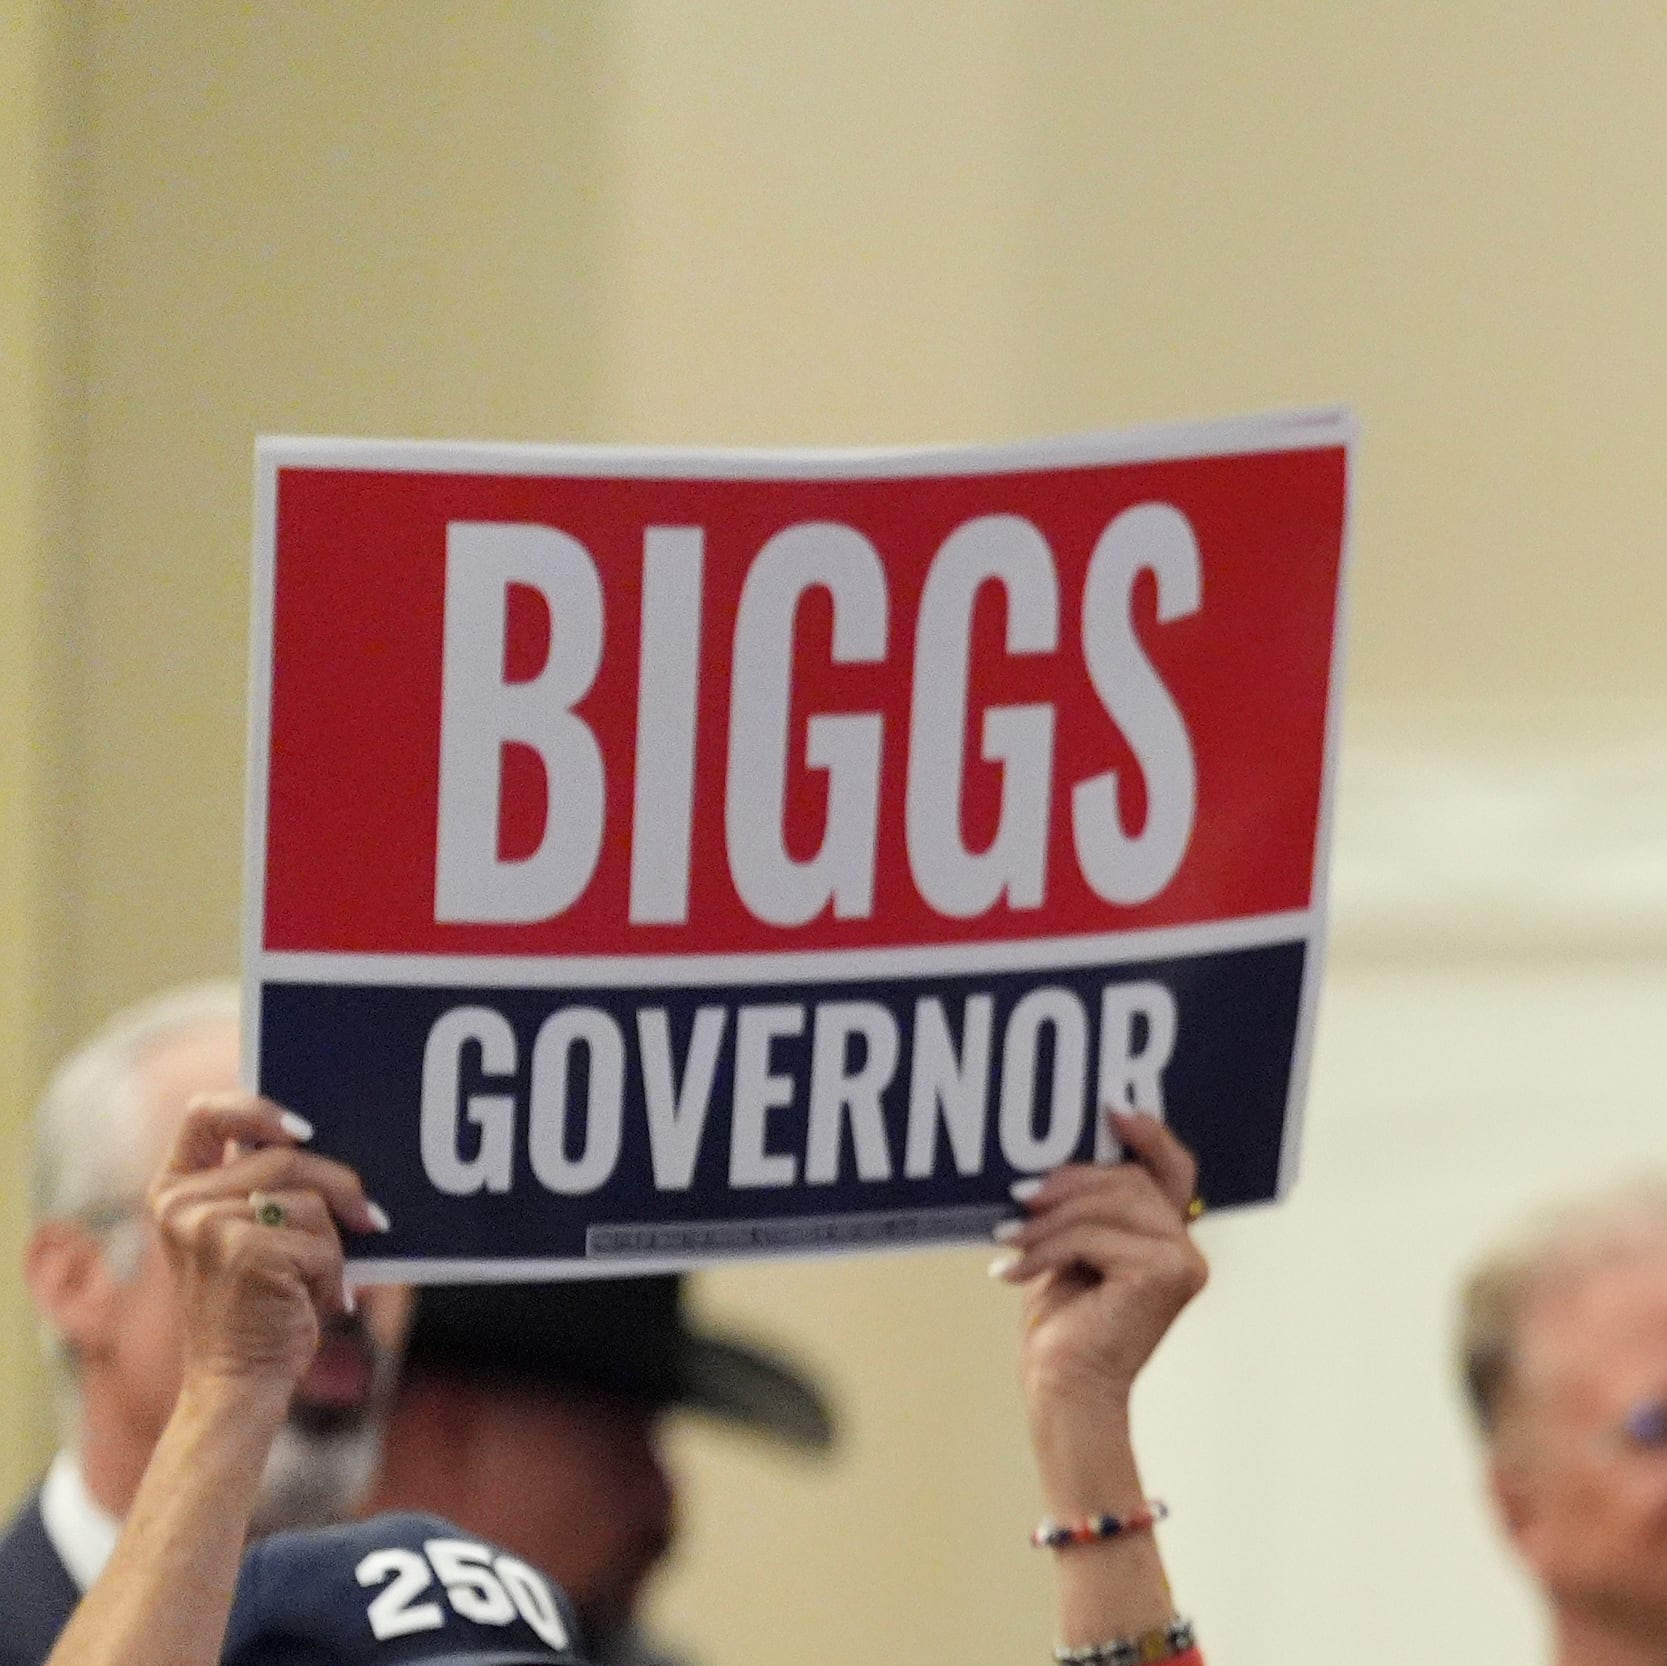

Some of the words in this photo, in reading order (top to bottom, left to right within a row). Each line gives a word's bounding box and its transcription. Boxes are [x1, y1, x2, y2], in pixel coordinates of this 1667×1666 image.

[432, 501, 1202, 927] BIGGS
[418, 981, 1178, 1195] GOVERNOR
[354, 1539, 569, 1652] 250
